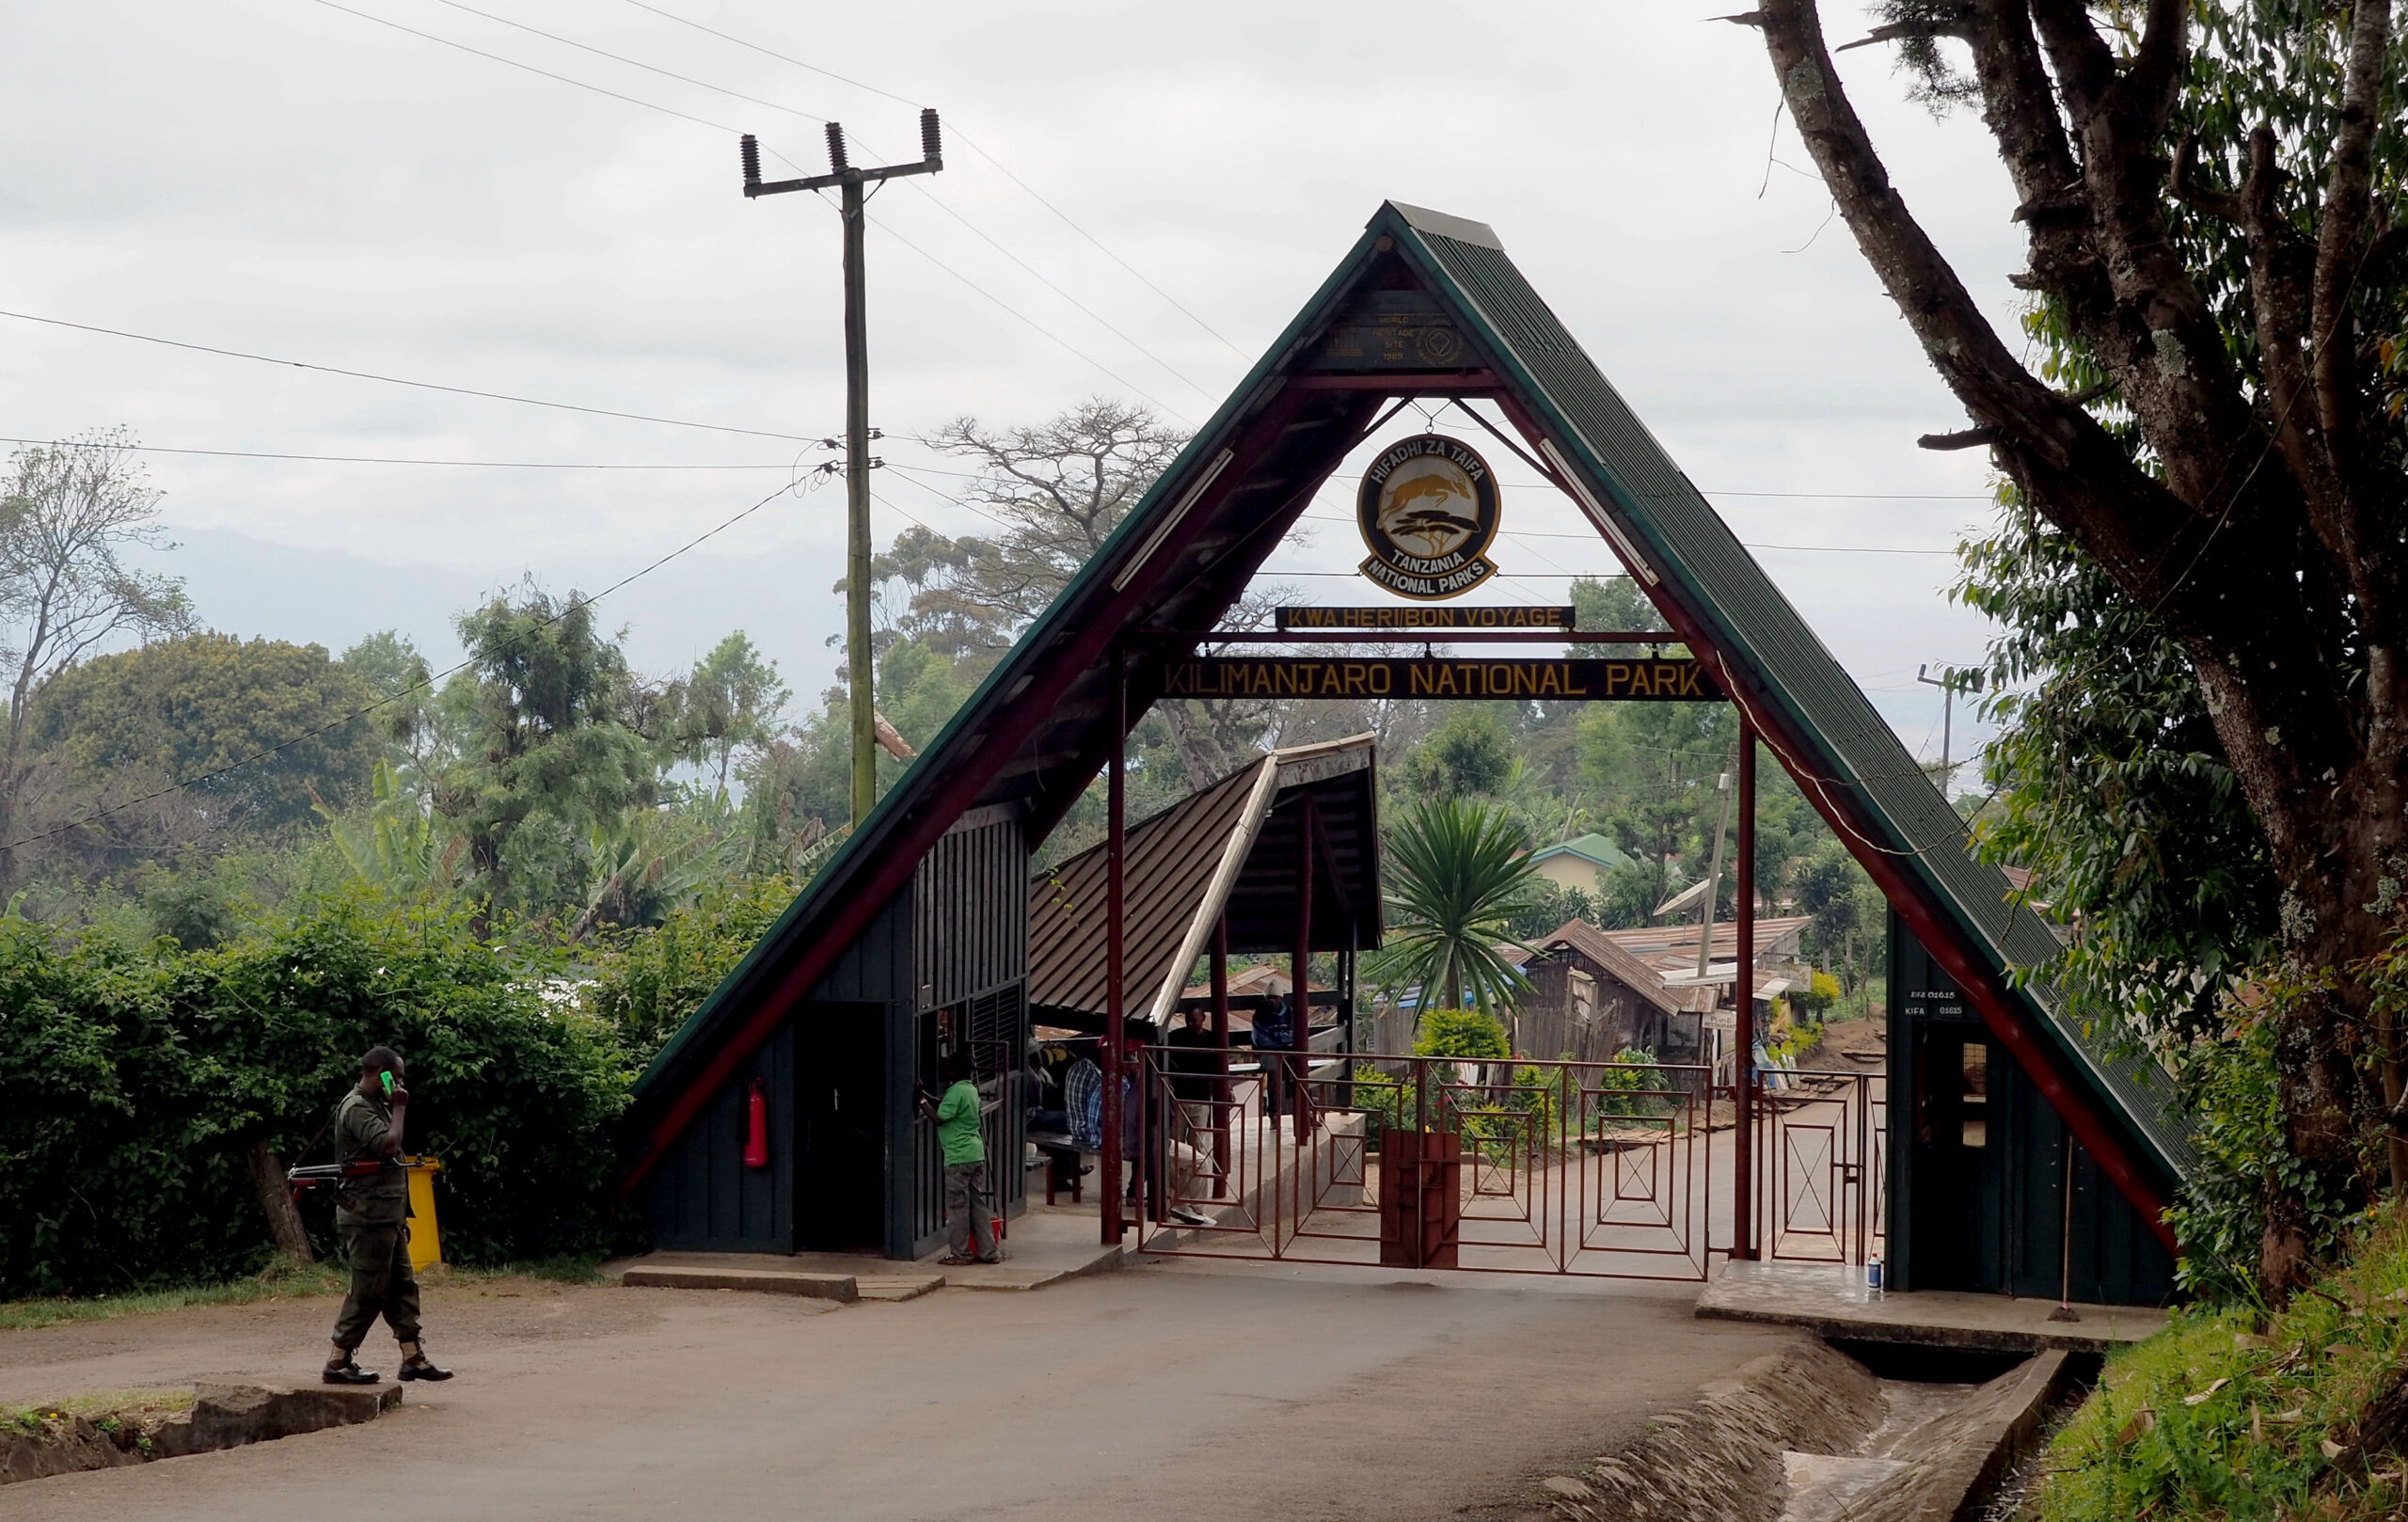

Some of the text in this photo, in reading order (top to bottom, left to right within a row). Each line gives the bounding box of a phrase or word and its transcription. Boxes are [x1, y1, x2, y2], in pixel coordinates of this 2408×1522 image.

[1379, 315, 1409, 324] WORLD
[1370, 440, 1485, 484] HIFADHI ZA TAIFA
[1390, 548, 1465, 574] TANZANIA
[1368, 560, 1485, 594] NATIONAL PARKS
[1464, 608, 1562, 627] VOYAGE
[1164, 663, 1703, 696] KILIMANJARO NATIONAL PARK
[1905, 1007, 1925, 1016] KIFA
